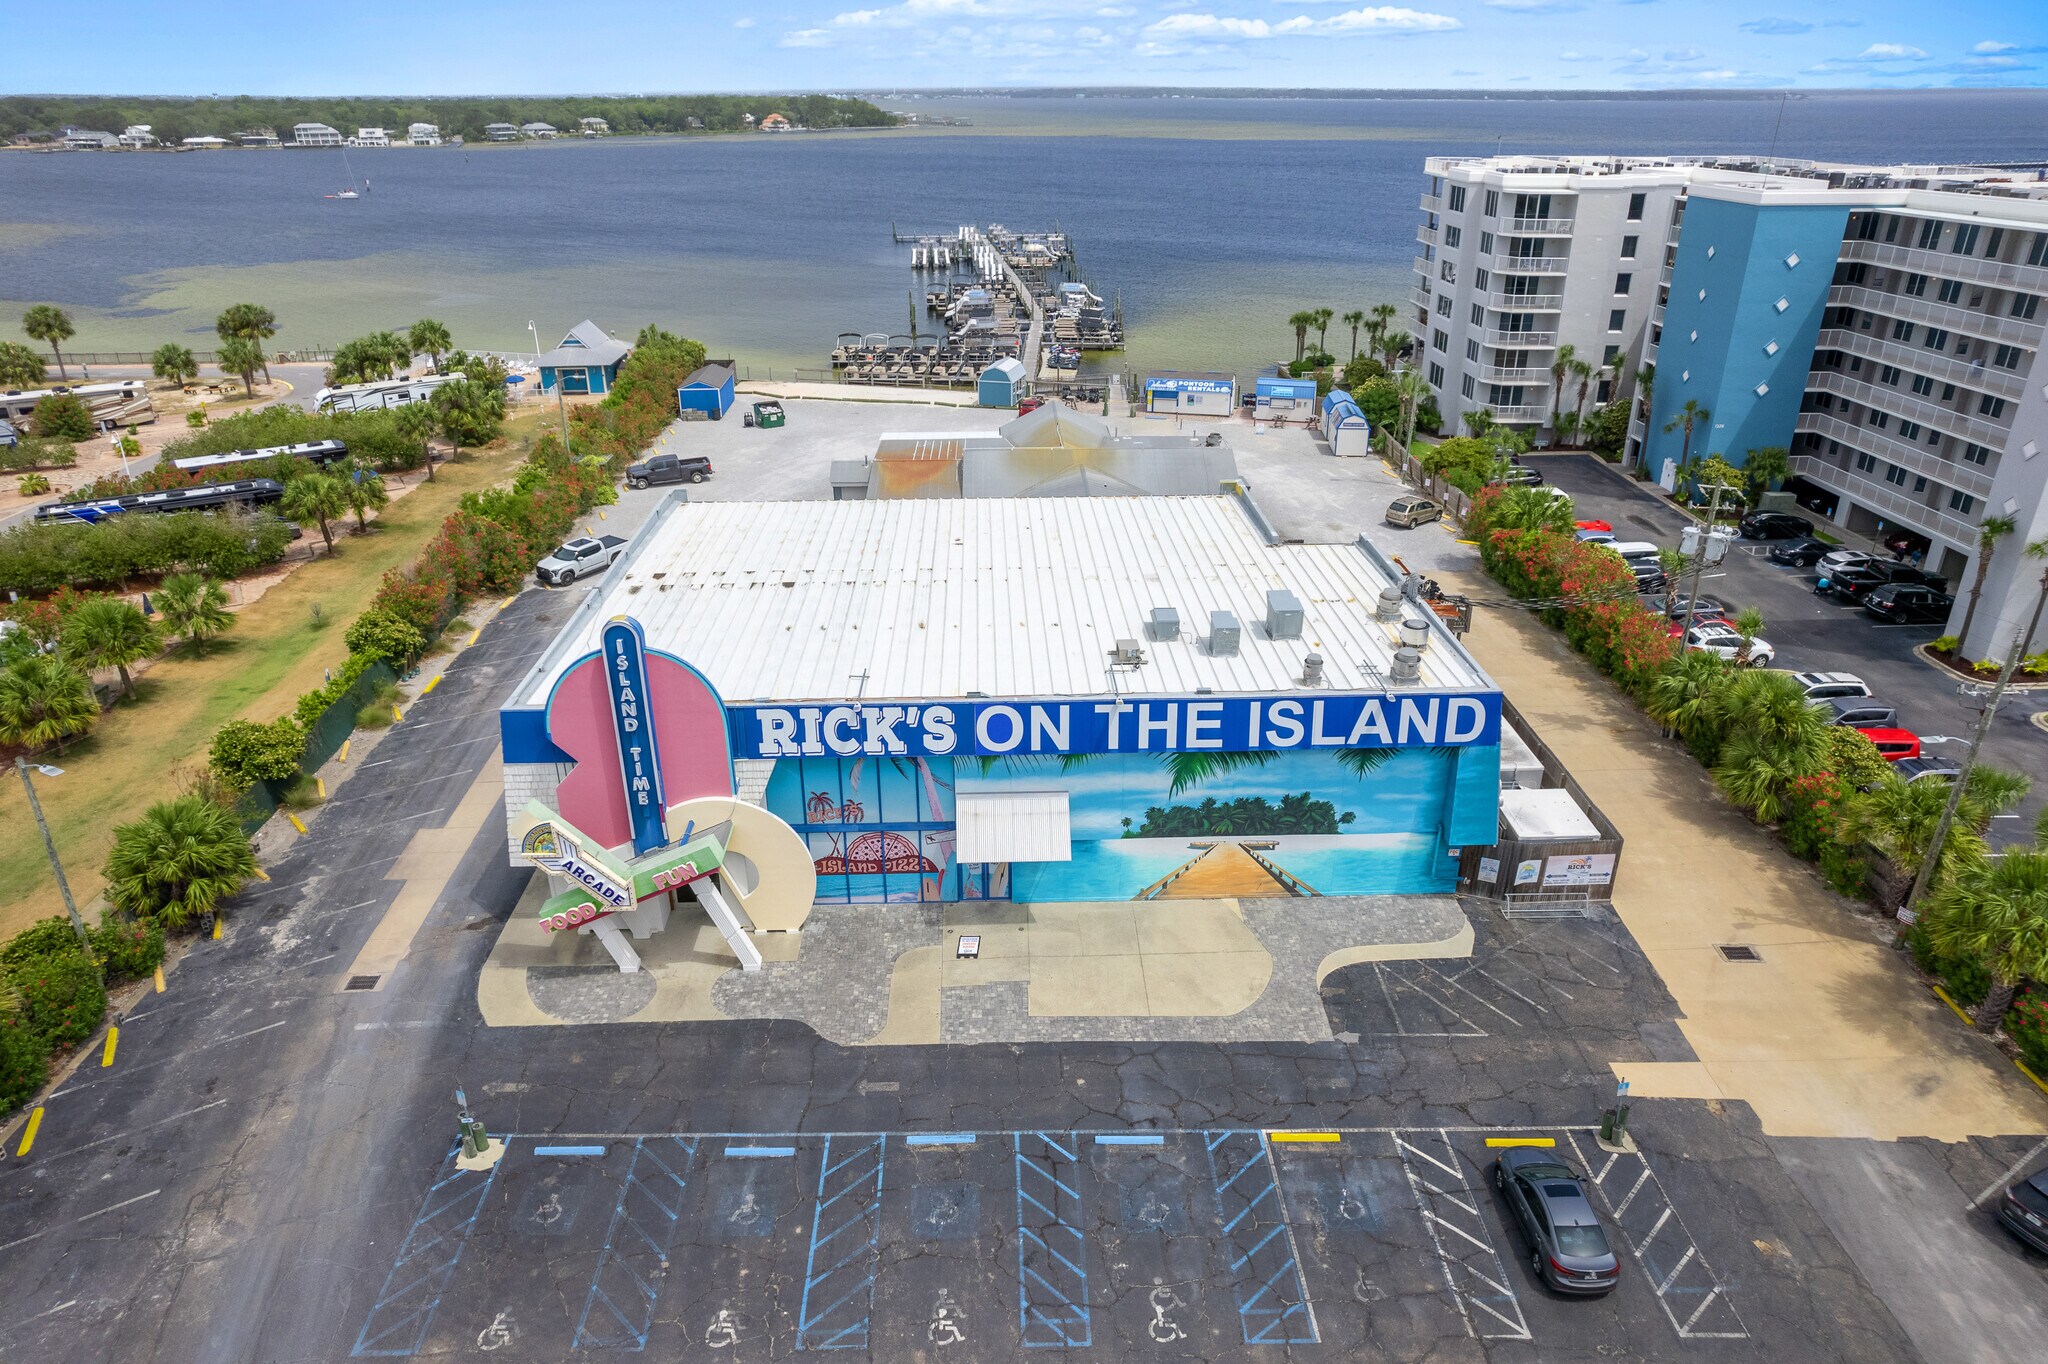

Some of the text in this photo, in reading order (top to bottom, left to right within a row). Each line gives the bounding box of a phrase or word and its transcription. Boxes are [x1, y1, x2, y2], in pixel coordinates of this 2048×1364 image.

[615, 638, 650, 806] ISLAND TIME
[756, 697, 1487, 757] RICK'S ON THE ISLAND
[561, 860, 625, 906] ARCADE
[652, 861, 699, 891] FUN
[821, 859, 878, 874] ISLAND
[538, 902, 597, 935] FOOD
